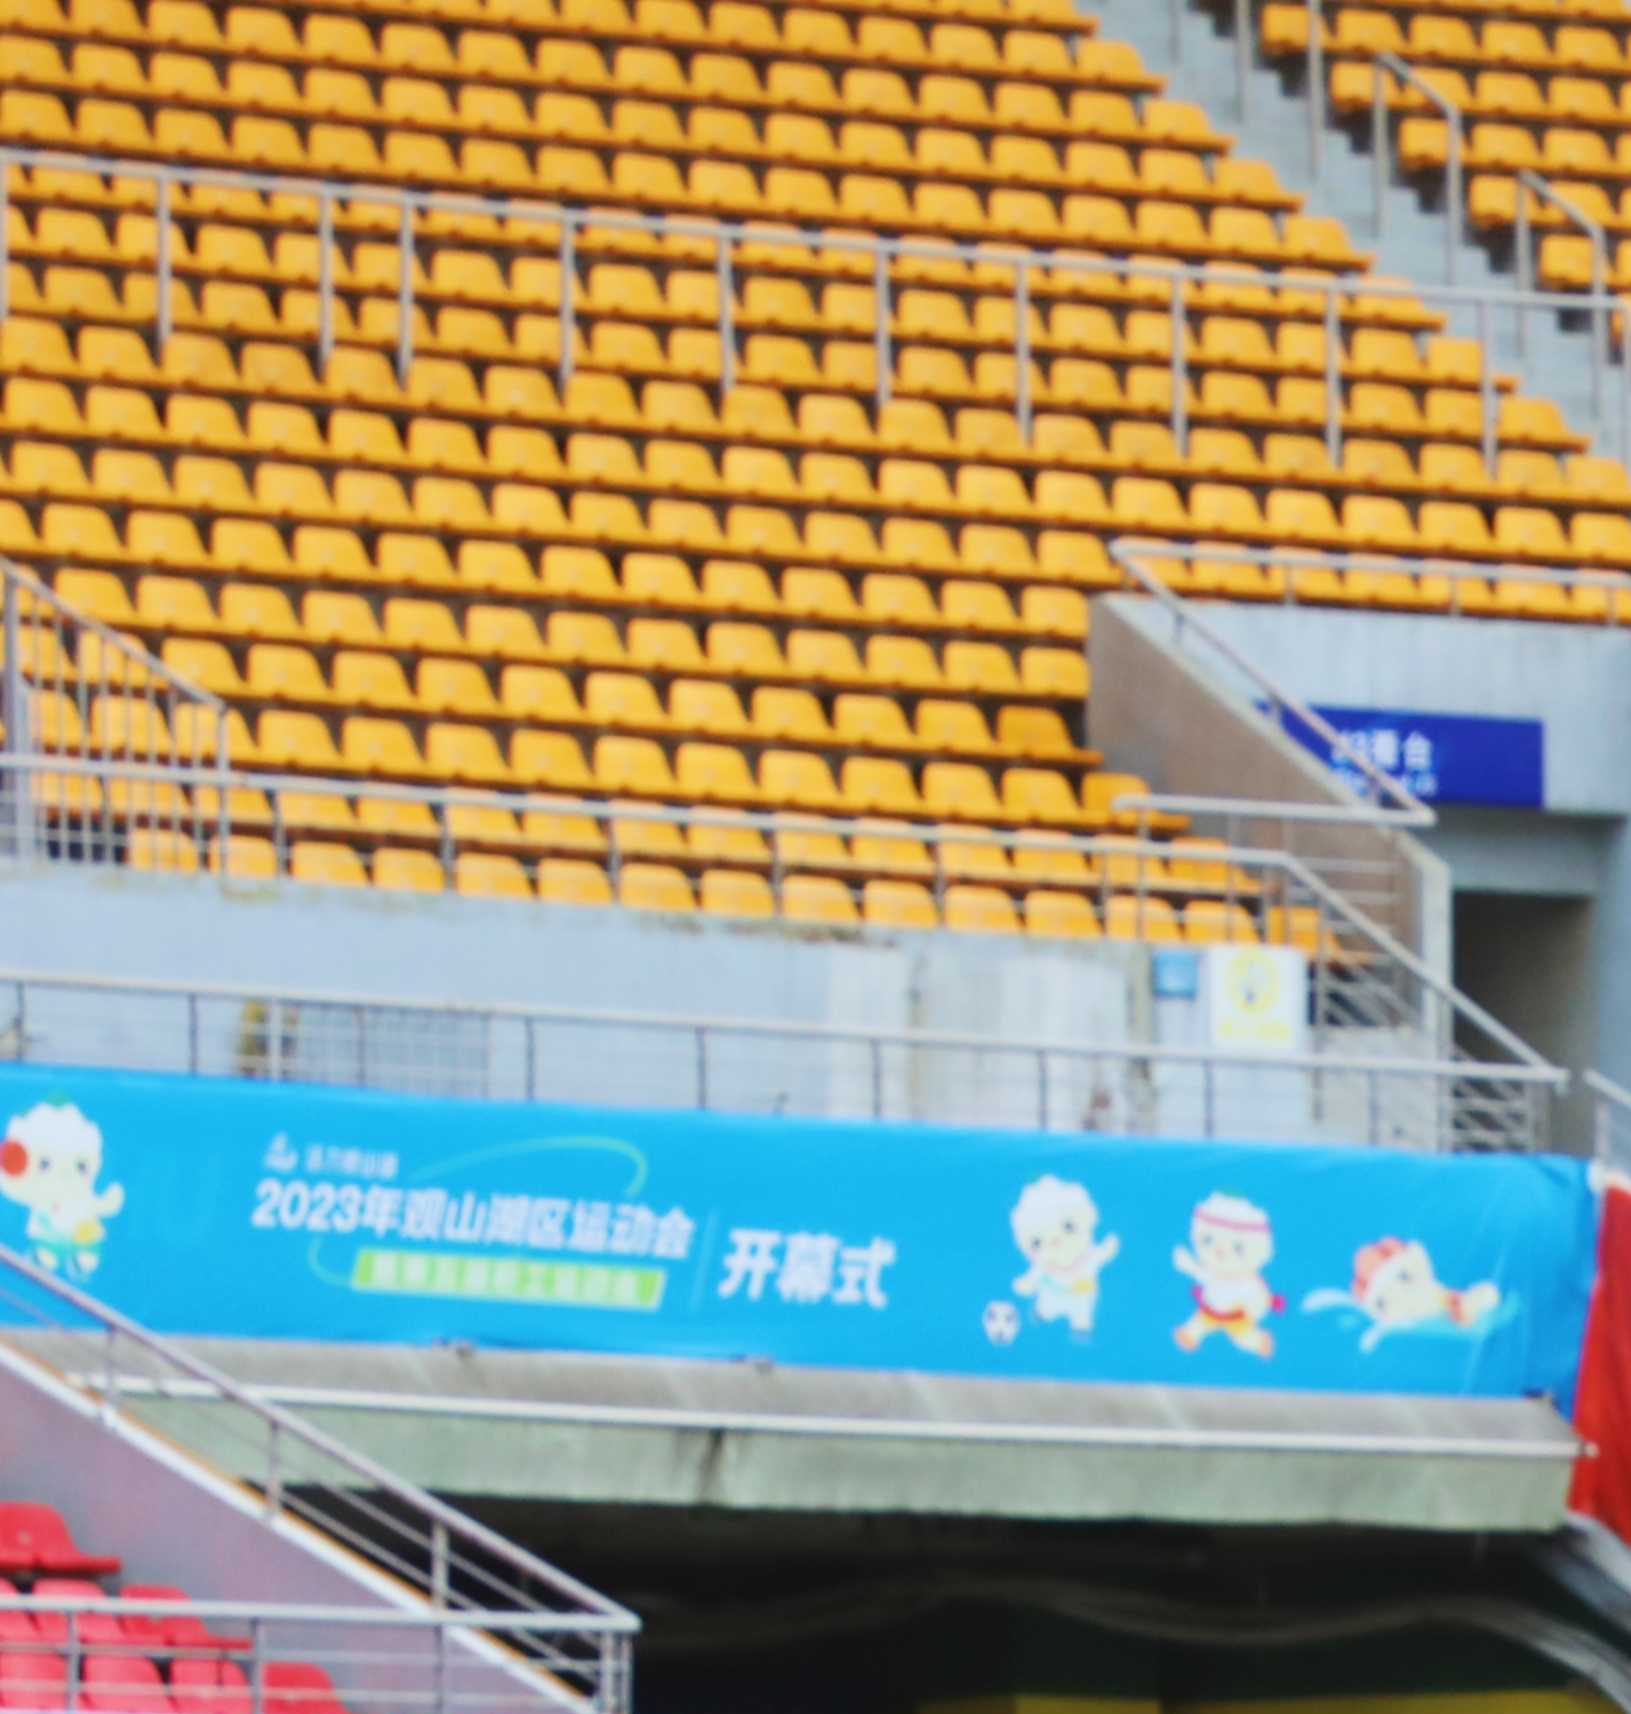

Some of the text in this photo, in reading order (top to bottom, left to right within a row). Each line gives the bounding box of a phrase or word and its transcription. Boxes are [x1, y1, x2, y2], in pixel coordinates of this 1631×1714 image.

[252, 1177, 696, 1259] 2023年观山湖区运动会
[718, 1229, 895, 1308] 开幕式
